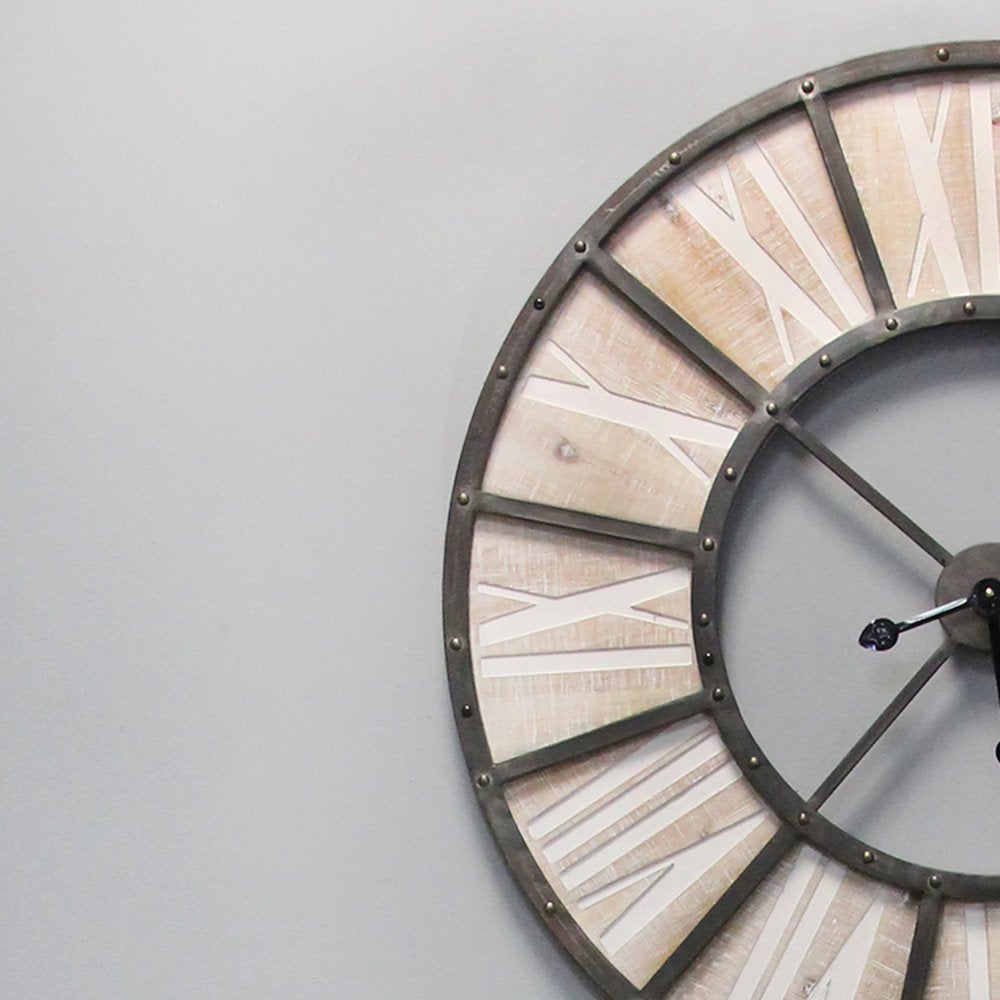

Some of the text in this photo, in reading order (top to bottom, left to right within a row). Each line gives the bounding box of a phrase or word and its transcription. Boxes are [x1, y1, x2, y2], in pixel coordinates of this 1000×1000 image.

[672, 137, 868, 366] XI
[521, 340, 742, 484] X
[477, 567, 693, 678] IX
[527, 716, 774, 956] VIII
